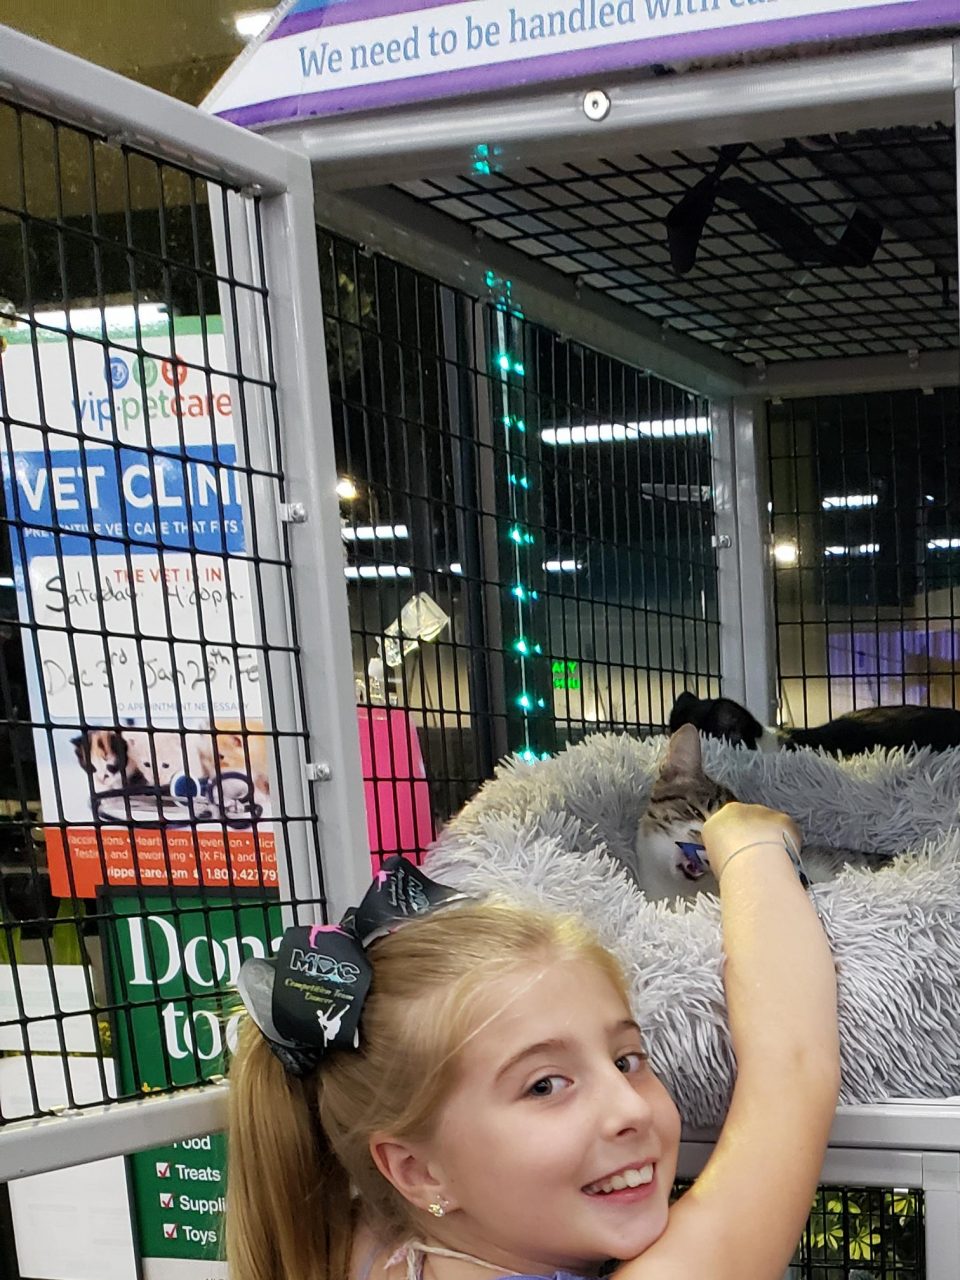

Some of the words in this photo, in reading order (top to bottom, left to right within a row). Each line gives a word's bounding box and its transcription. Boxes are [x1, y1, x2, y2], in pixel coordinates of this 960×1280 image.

[299, 41, 342, 78] We
[350, 26, 420, 70] need
[429, 27, 458, 57] to
[466, 16, 500, 50] be
[509, 0, 635, 43] handled
[20, 466, 104, 511] VET
[206, 567, 222, 581] IN
[290, 948, 360, 984] MDC
[173, 1135, 211, 1150] ood
[175, 1163, 222, 1182] Treats
[182, 1226, 217, 1244] Toys
